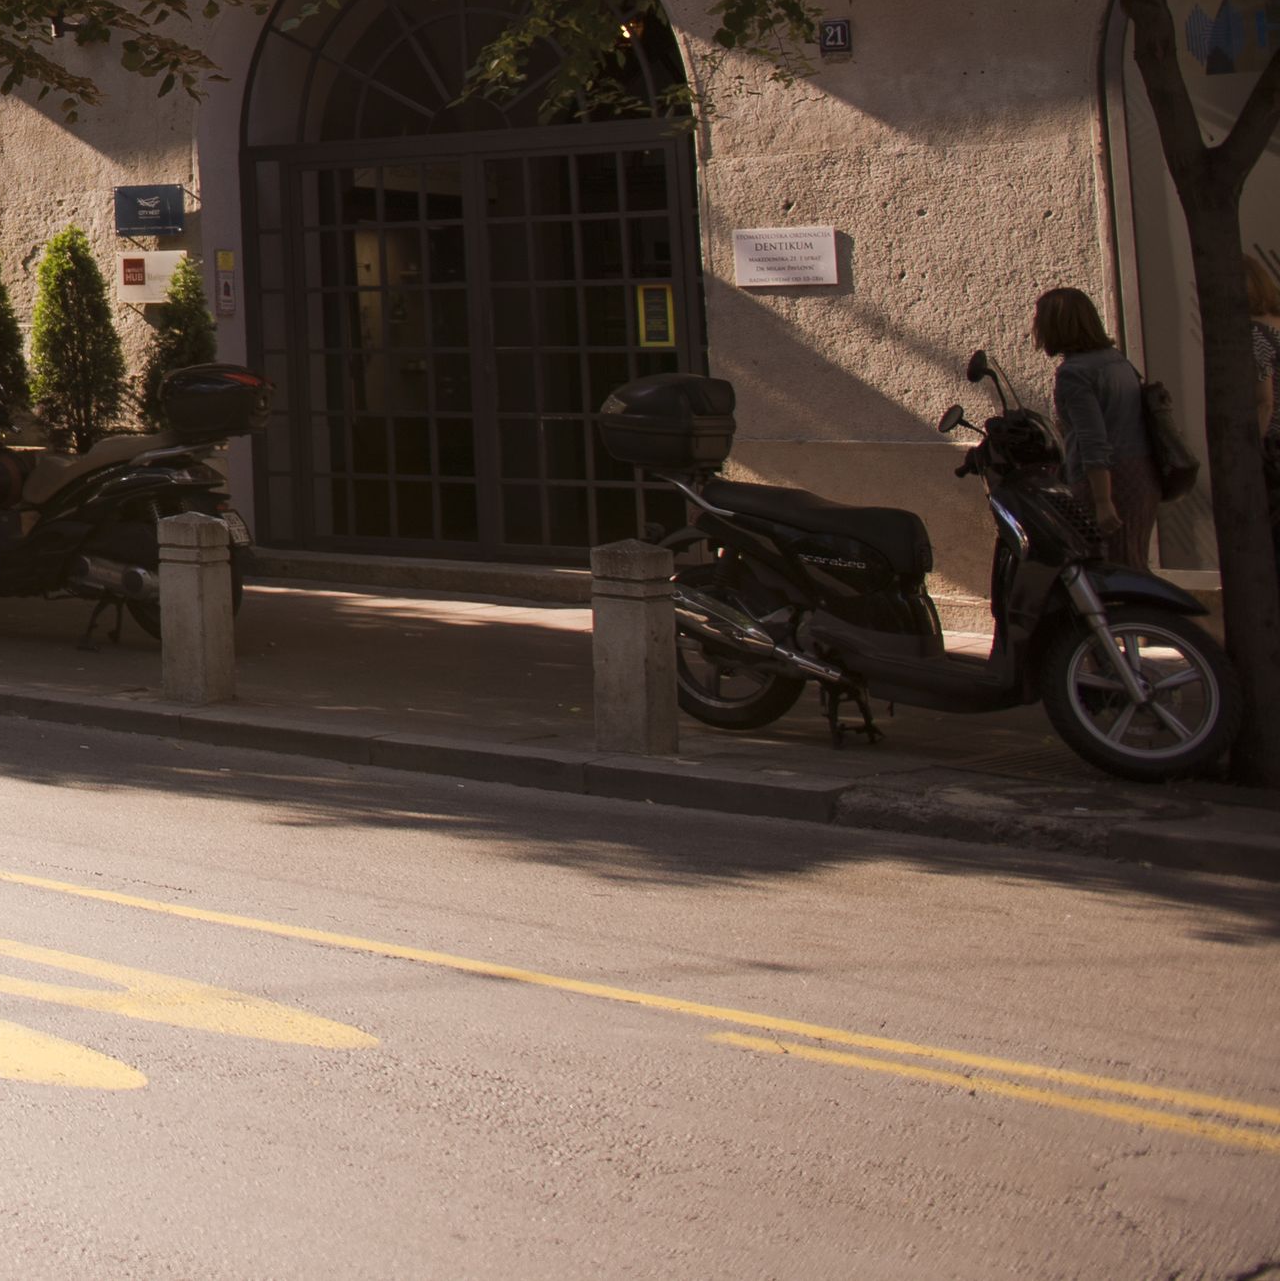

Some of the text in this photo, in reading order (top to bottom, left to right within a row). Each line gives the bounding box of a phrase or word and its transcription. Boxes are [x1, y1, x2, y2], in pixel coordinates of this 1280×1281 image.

[826, 25, 845, 46] 21
[755, 242, 813, 251] DENTIKUM
[125, 273, 143, 282] HUB
